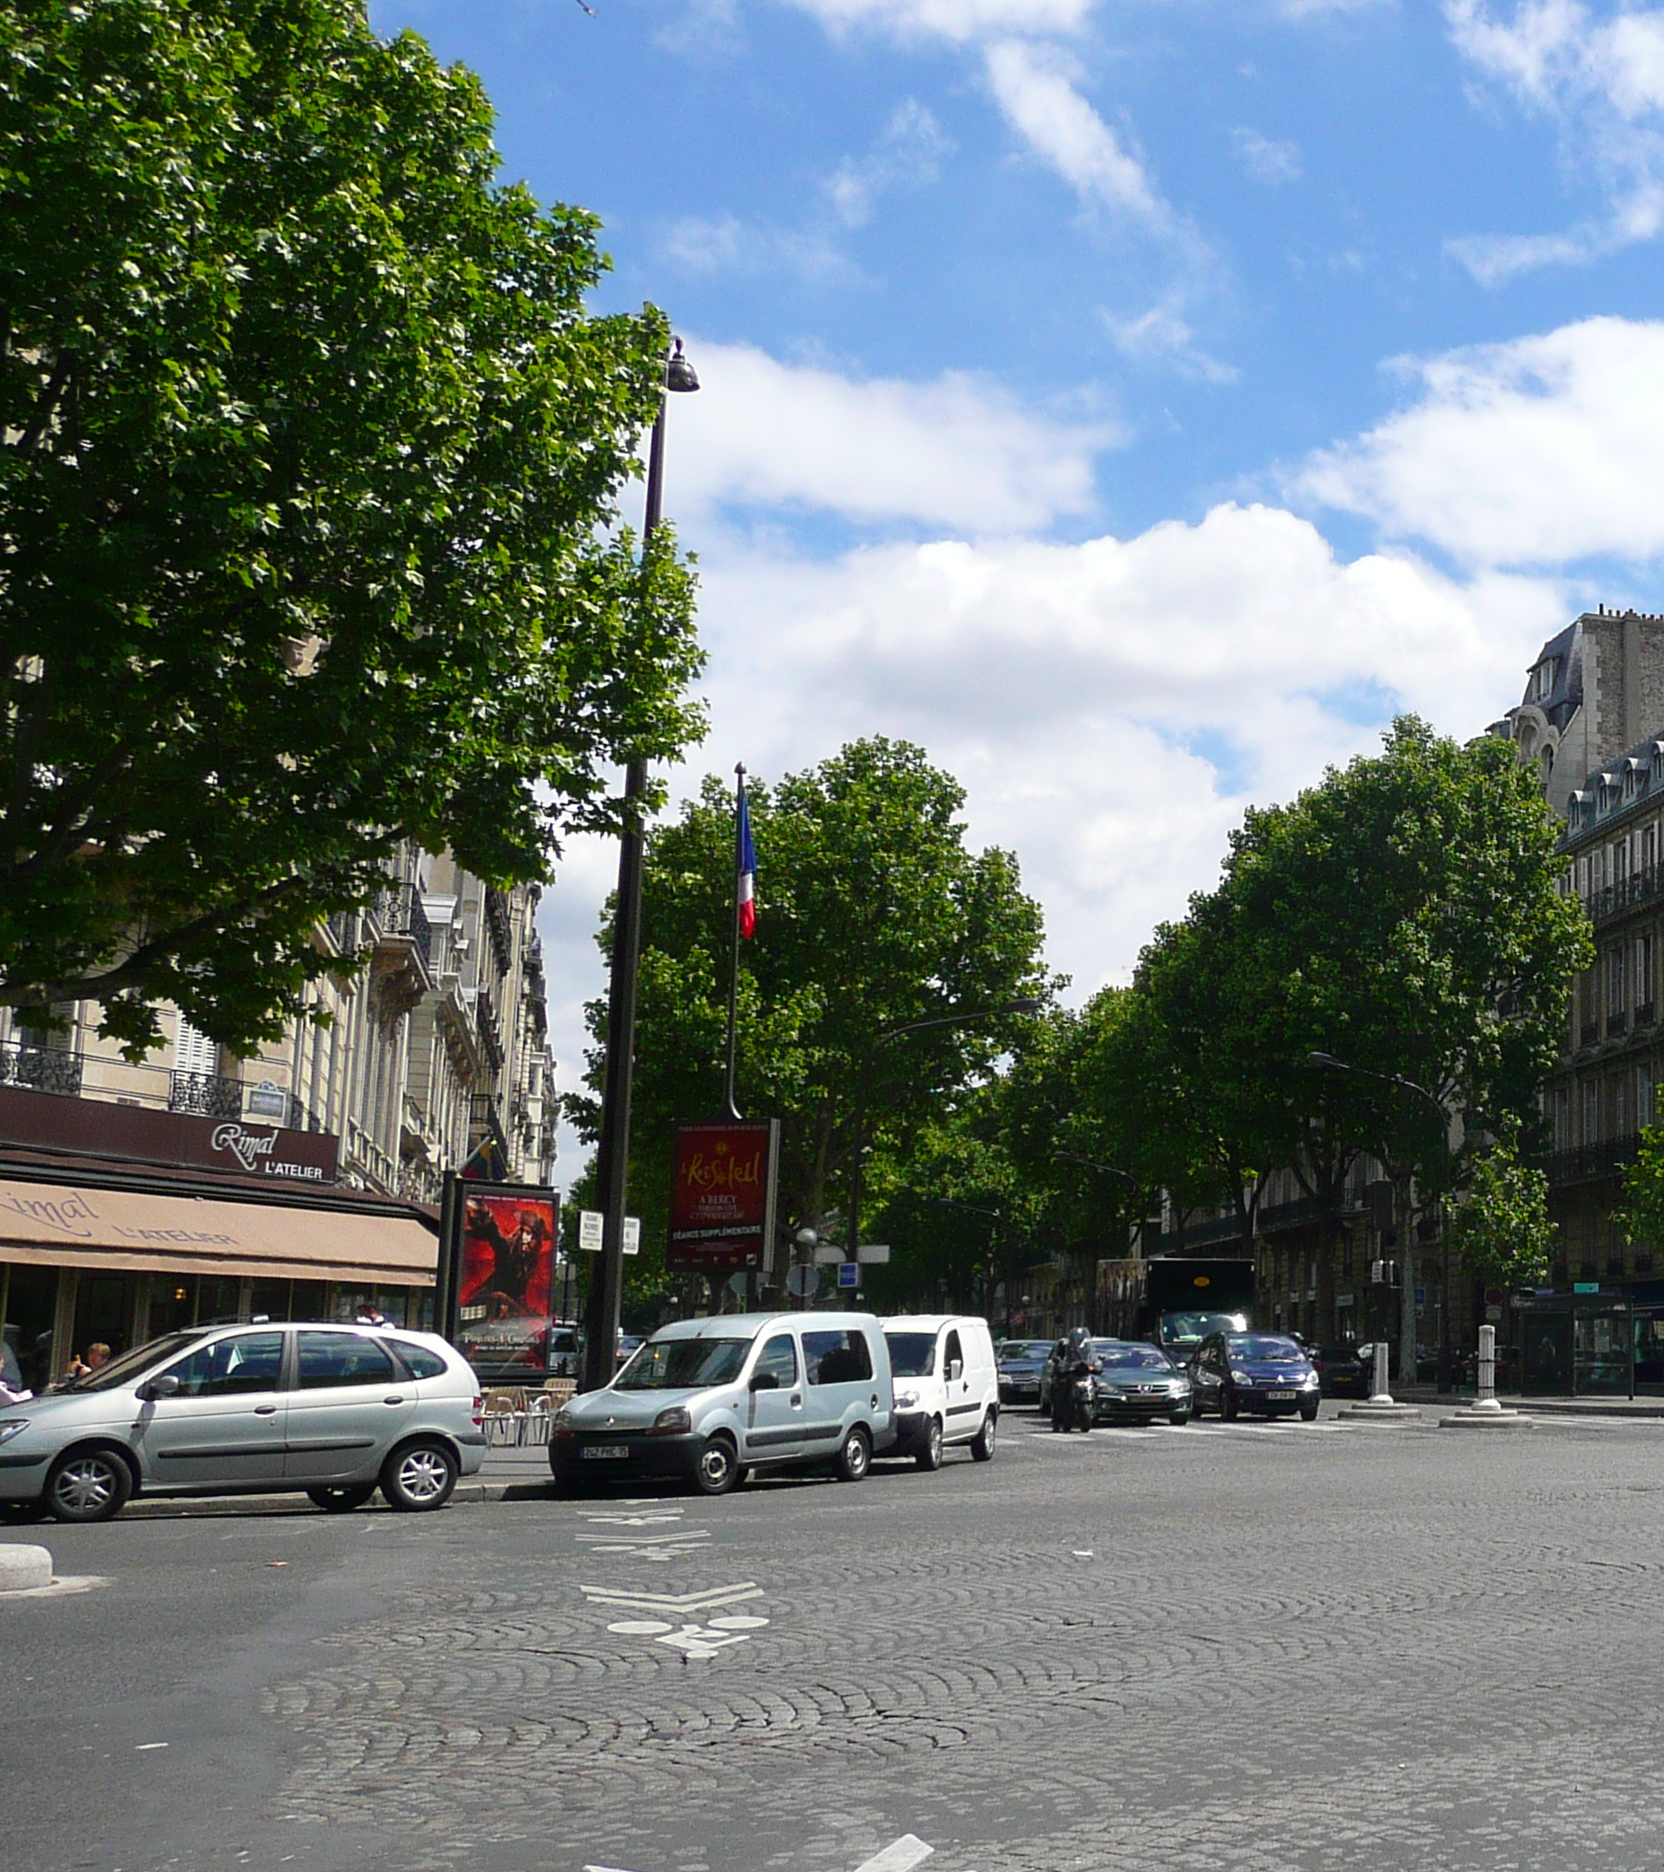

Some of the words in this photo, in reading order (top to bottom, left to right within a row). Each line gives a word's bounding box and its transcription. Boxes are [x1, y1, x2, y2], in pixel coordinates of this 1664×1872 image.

[211, 1123, 280, 1171] Rimal
[265, 1160, 323, 1179] L'ATELIER
[0, 1191, 99, 1238] imal
[112, 1224, 240, 1246] L'ATELIER
